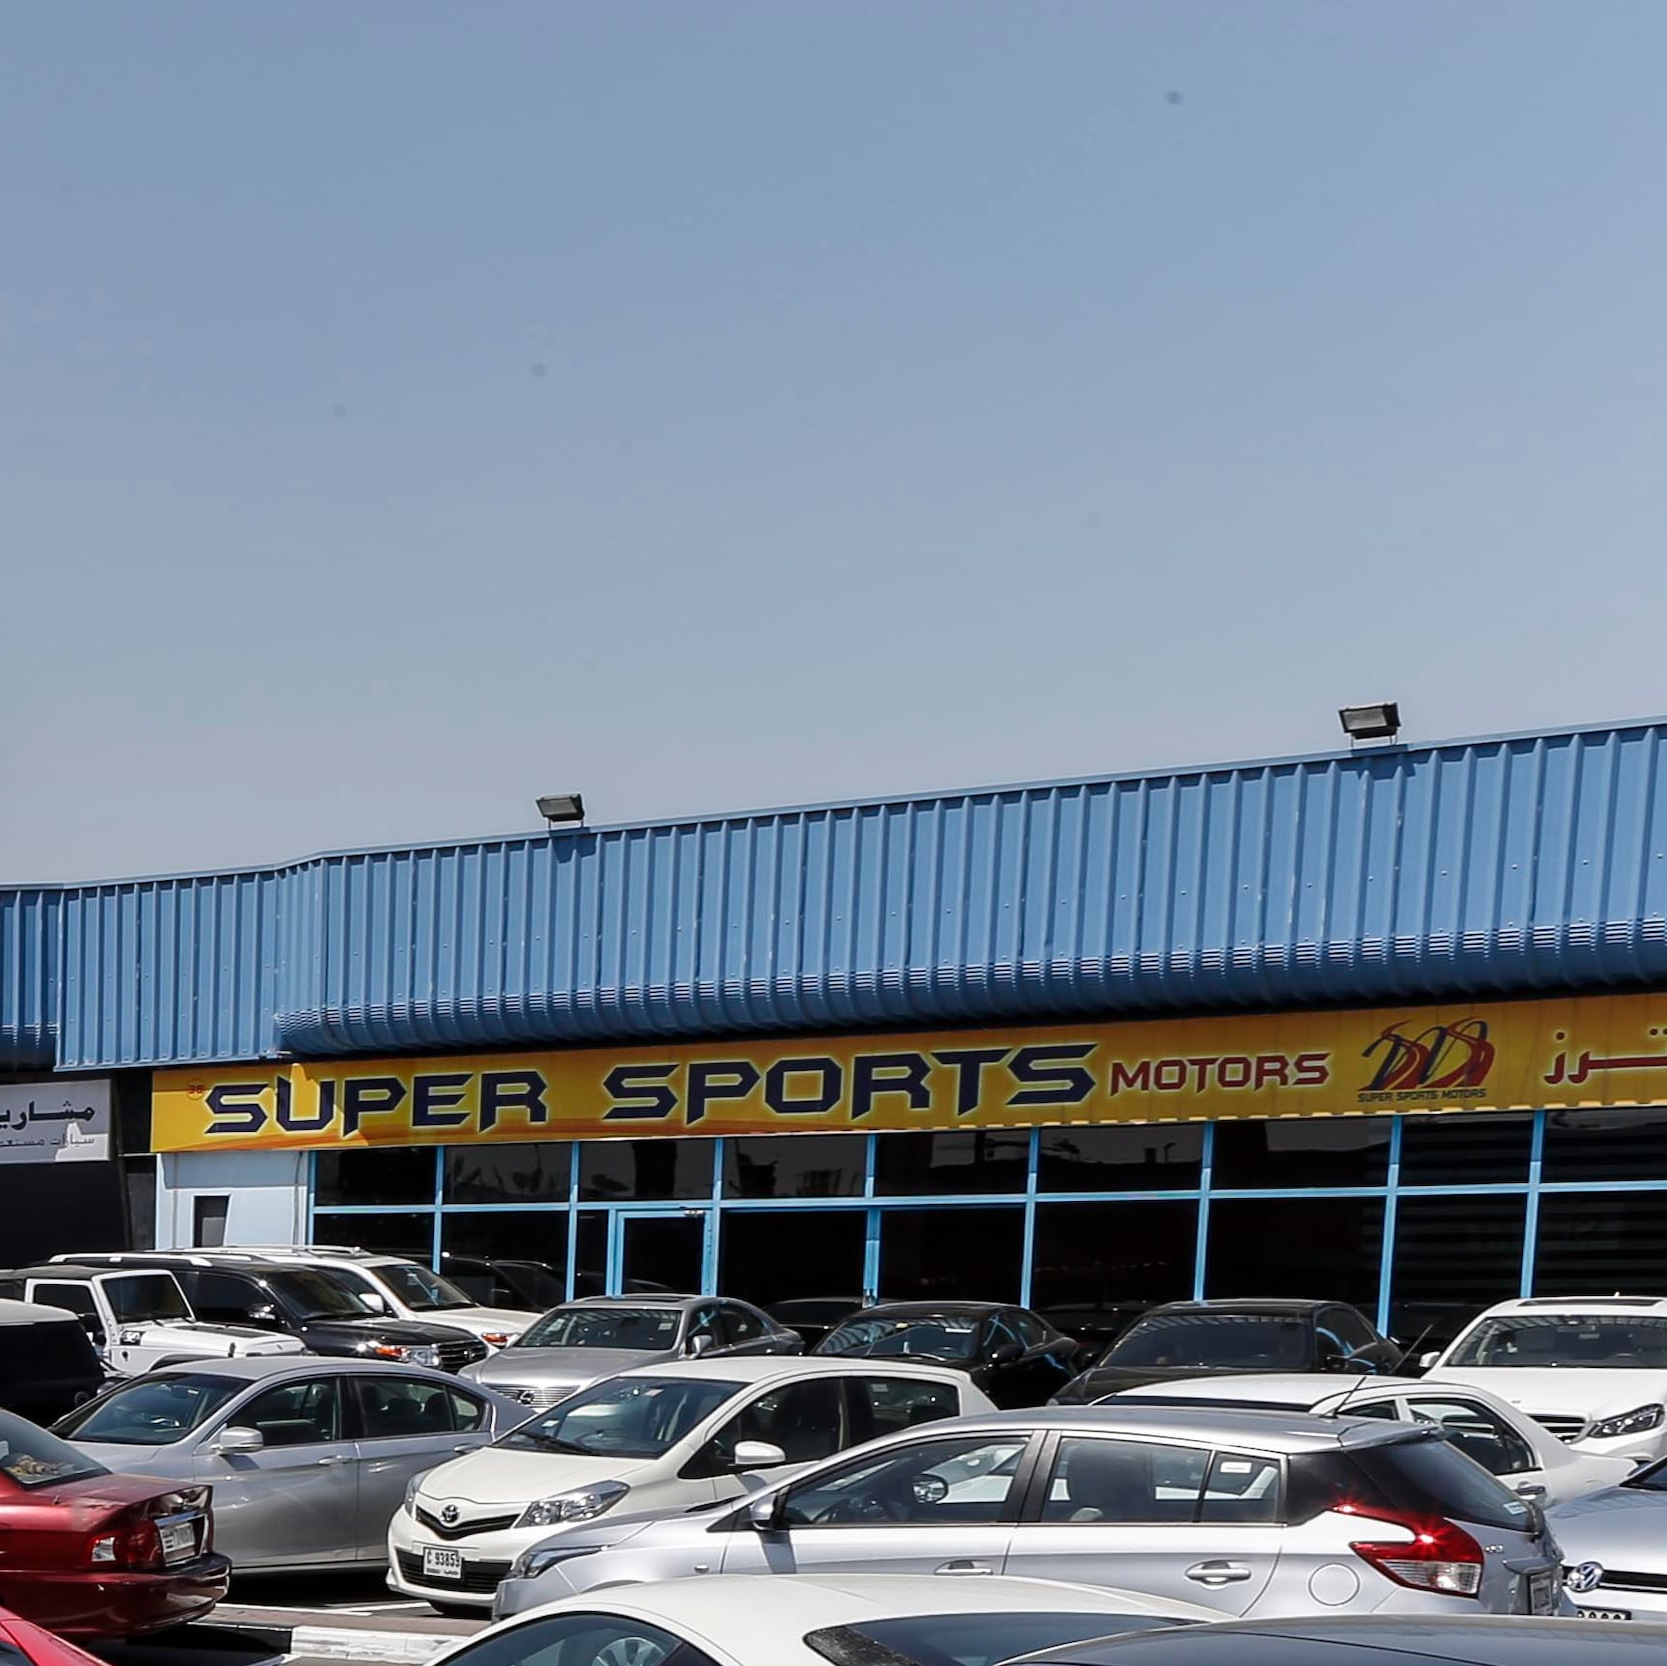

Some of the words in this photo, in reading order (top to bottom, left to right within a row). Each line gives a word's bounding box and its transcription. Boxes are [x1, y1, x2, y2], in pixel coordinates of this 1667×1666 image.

[203, 1070, 549, 1138] SUPER
[601, 1043, 1099, 1126] SPORTS
[1110, 1052, 1331, 1097] MOTORS
[1397, 1090, 1436, 1101] SPORTS
[1441, 1088, 1487, 1098] MOTORS
